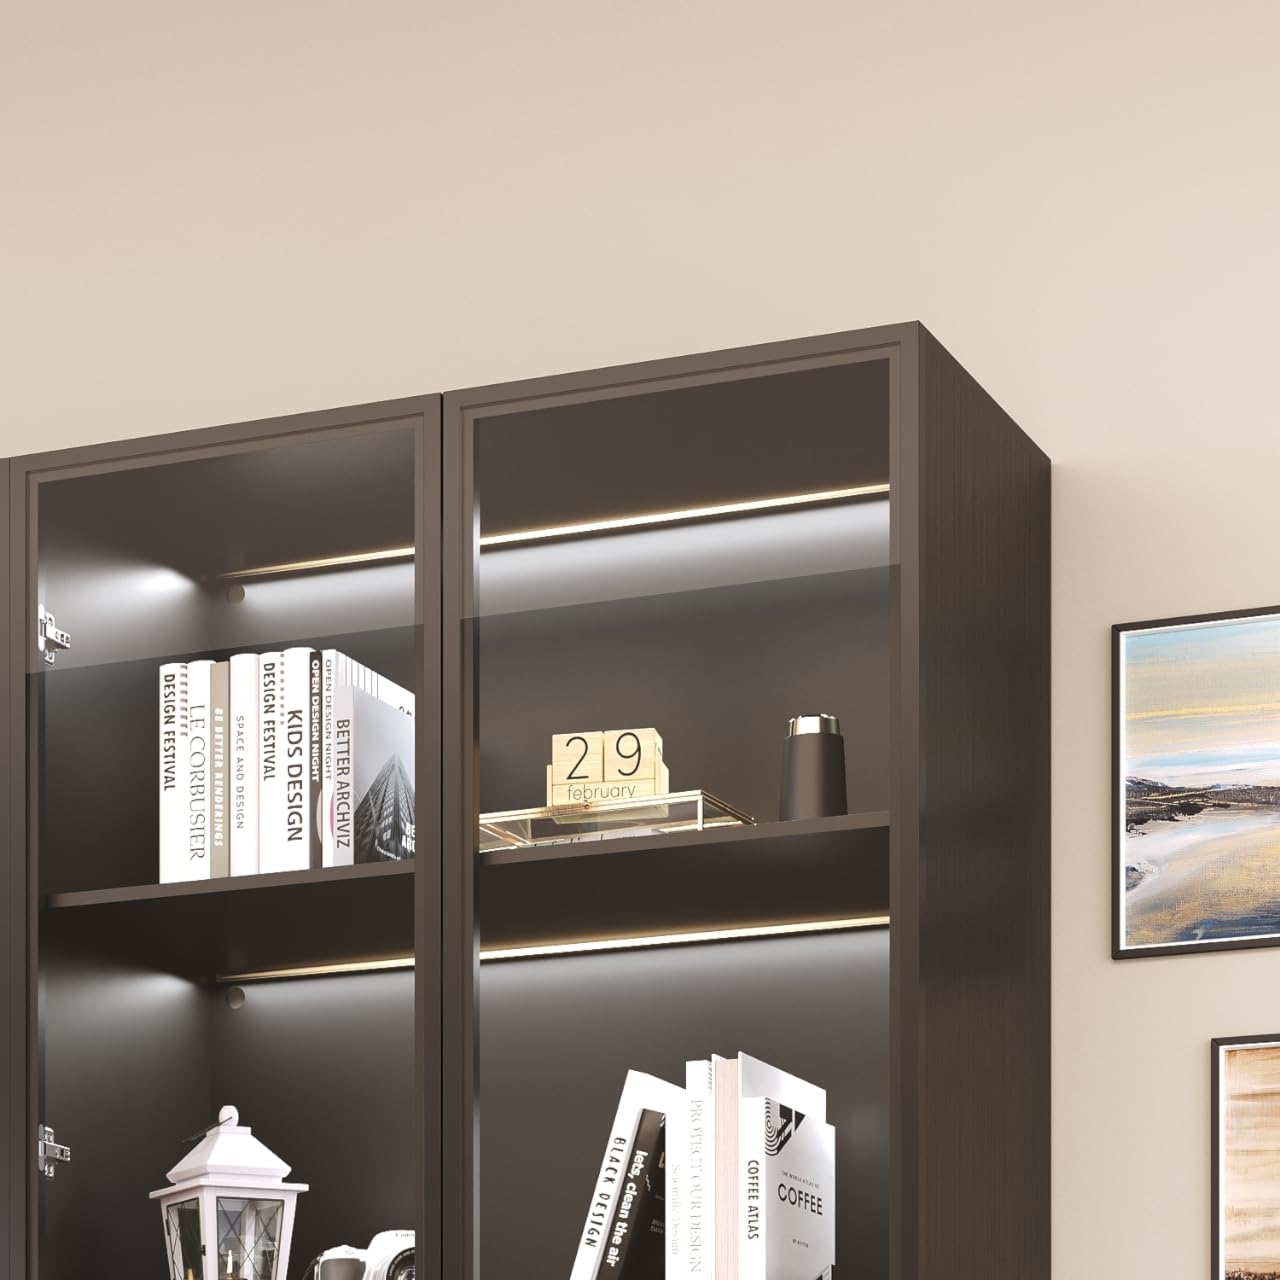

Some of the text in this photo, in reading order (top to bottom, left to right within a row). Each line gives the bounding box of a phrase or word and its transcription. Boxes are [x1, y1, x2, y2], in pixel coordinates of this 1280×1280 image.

[164, 674, 175, 791] DESIGN FESTIVAL
[236, 716, 244, 829] SPACE AND DESIGN
[264, 663, 275, 781] DESIGN FESTIVAL
[287, 710, 302, 841] KIDS DESIGN
[190, 705, 205, 861] LE CORBUSIER
[337, 719, 350, 848] BETTER ARCHVIZ
[568, 784, 635, 800] february
[585, 1137, 626, 1248] BLACK DESIGN
[606, 1150, 648, 1267] lets, clean the air
[748, 1159, 759, 1240] COFFEE ATLAS
[778, 1183, 822, 1216] COFFEE
